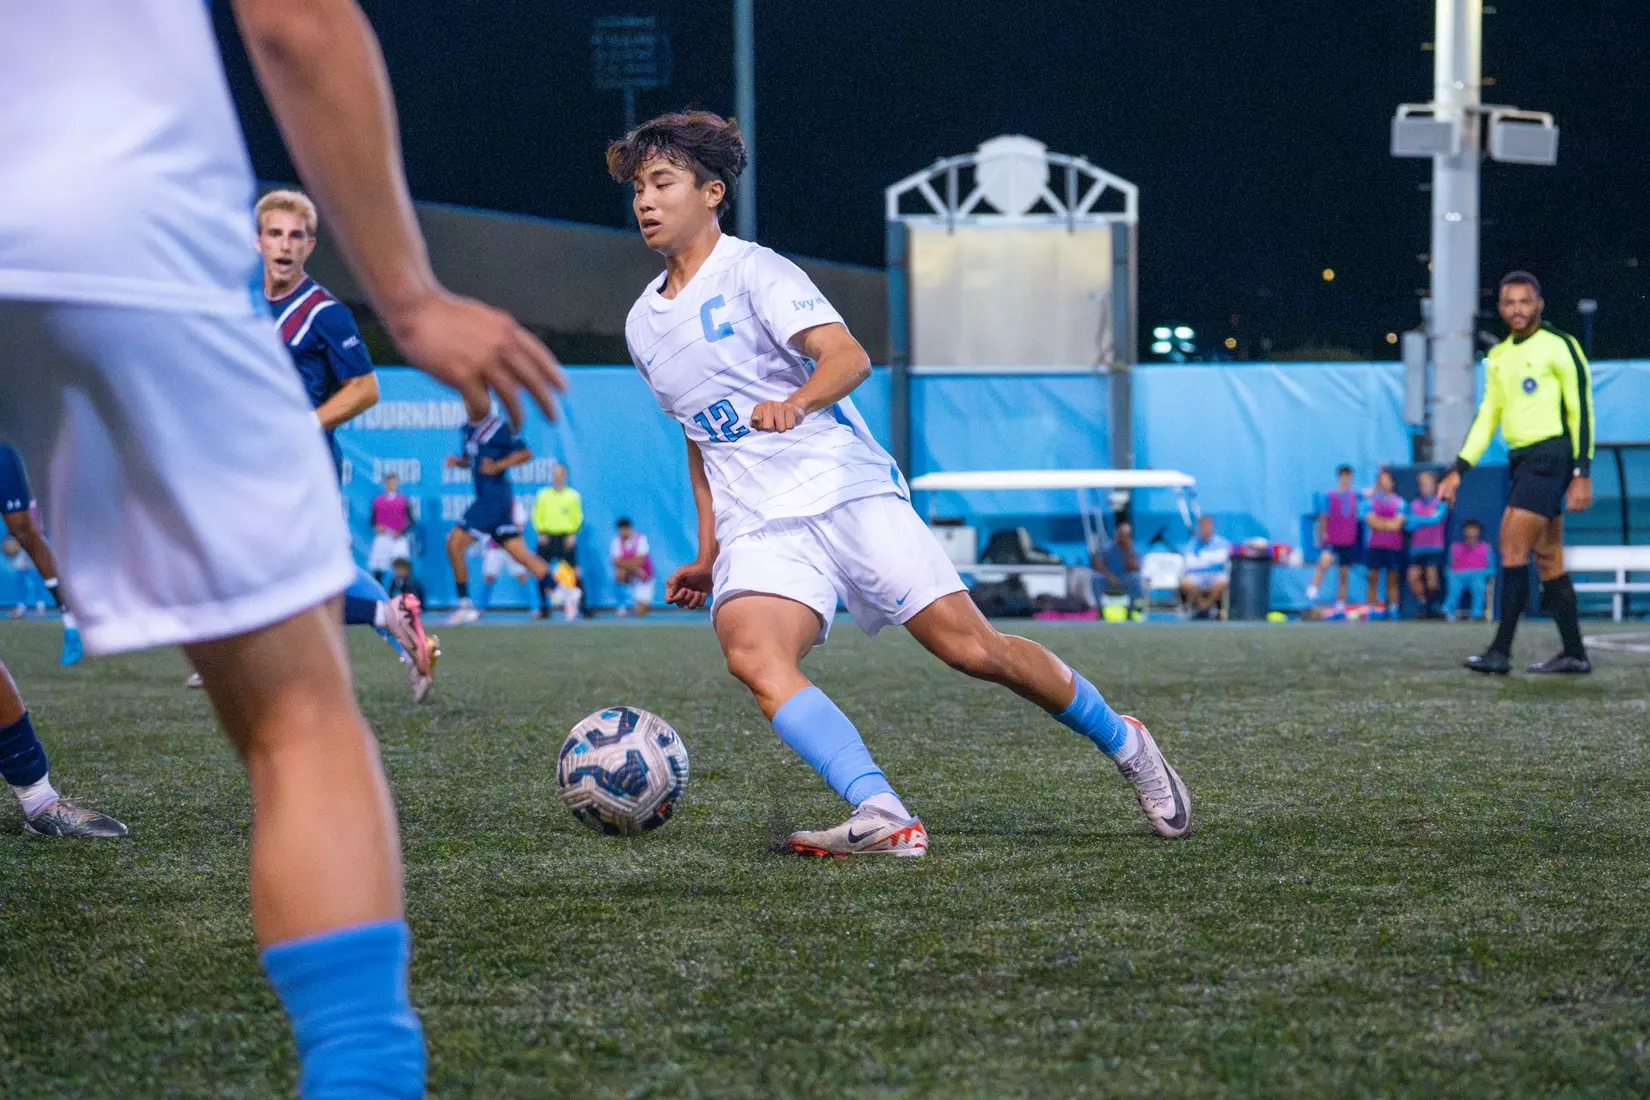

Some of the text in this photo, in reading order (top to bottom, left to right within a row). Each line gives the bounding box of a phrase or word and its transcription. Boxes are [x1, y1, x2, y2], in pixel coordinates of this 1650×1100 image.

[700, 294, 735, 343] C
[791, 298, 815, 311] Ivy
[693, 399, 751, 442] 12
